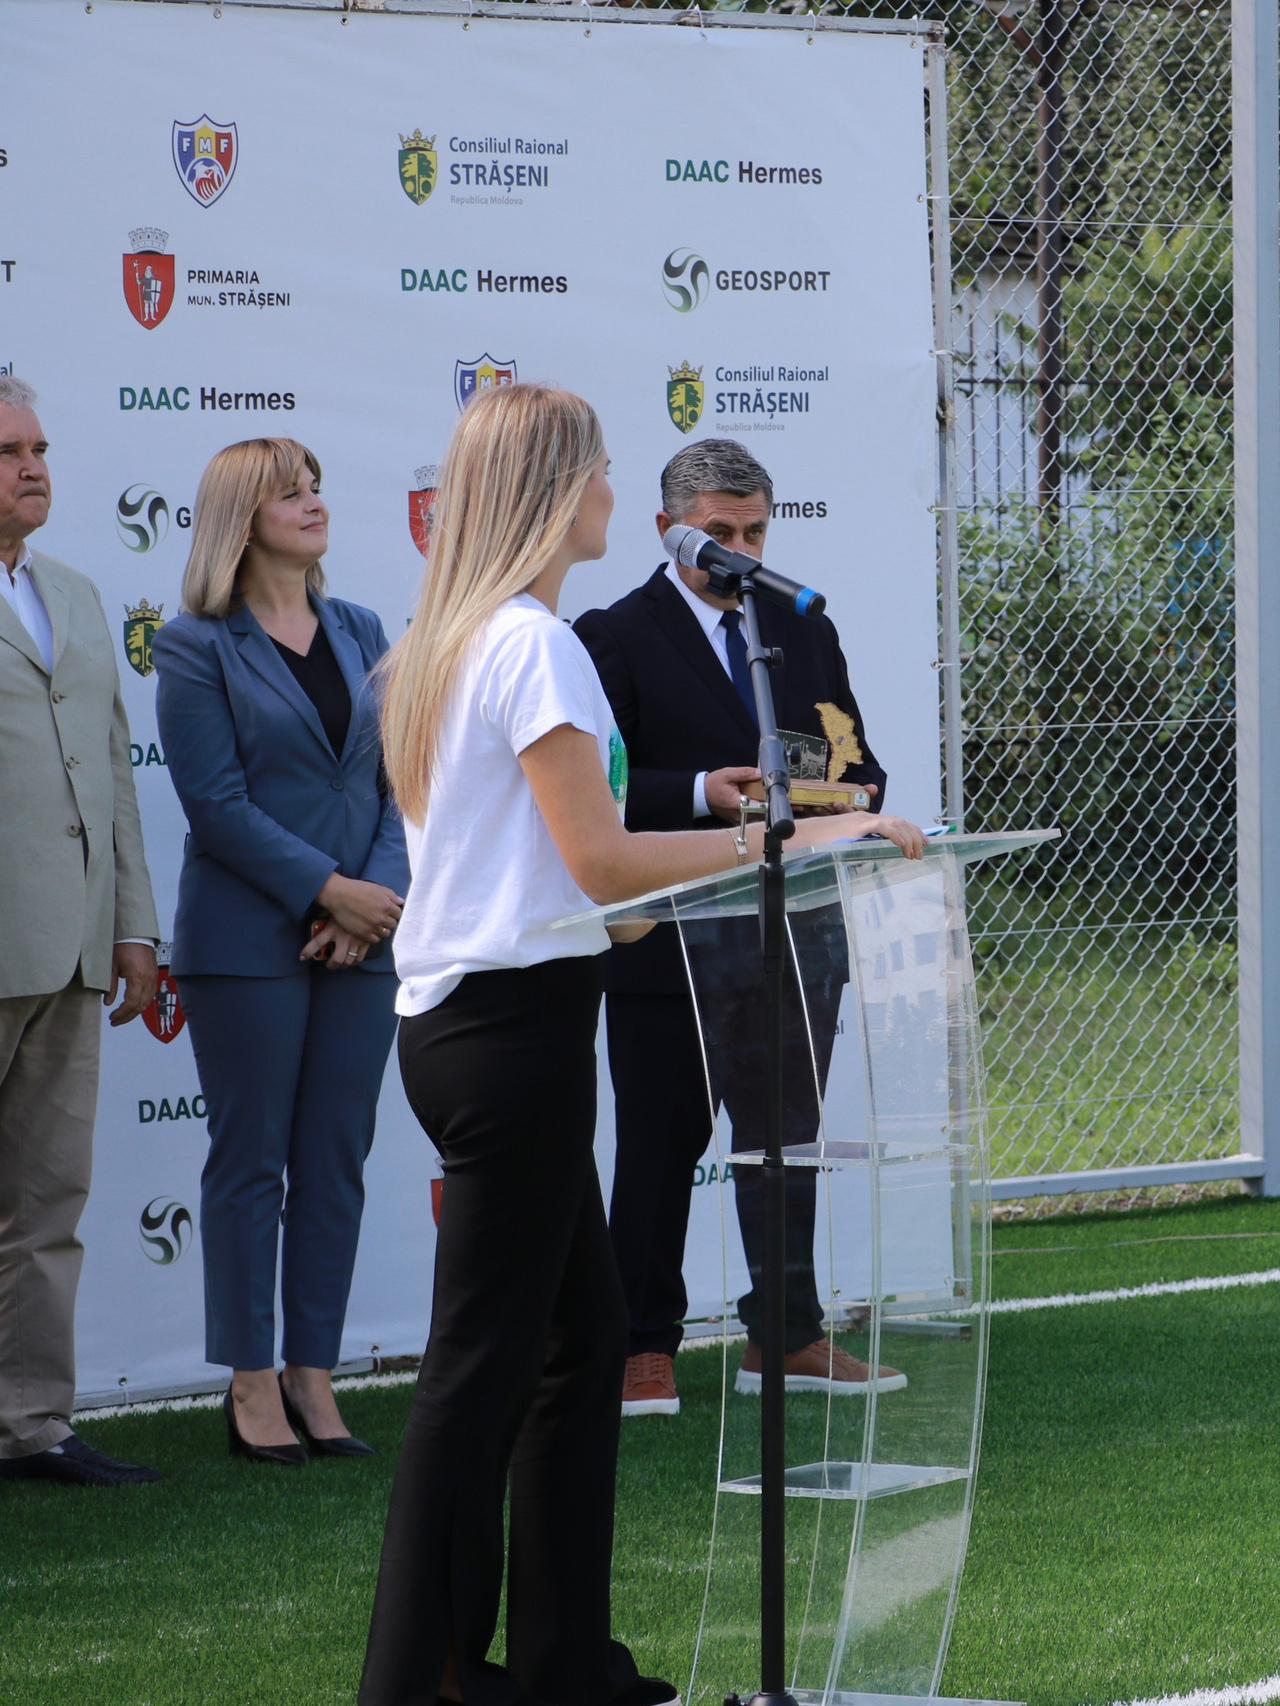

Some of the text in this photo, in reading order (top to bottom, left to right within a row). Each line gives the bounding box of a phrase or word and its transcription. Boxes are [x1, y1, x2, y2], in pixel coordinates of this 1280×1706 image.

[182, 136, 229, 153] FMF
[450, 137, 568, 155] Consiliul Raional
[450, 160, 548, 193] STRĂȘENI
[666, 159, 823, 184] DAAC Hermes
[450, 195, 523, 205] Republica Moldova
[188, 270, 259, 284] PRIMARIA
[401, 269, 568, 293] DAAC Hermes
[716, 270, 831, 292] GEOSPORT
[188, 288, 290, 309] MUN. STRĂȘENI
[716, 366, 829, 381] Consiliul Raional
[120, 387, 295, 411] DAAC Hermes
[715, 388, 810, 419] STRĂȘENI
[715, 422, 785, 432] Republica Moldova
[772, 501, 827, 518] rmes
[693, 1162, 737, 1187] DAA
